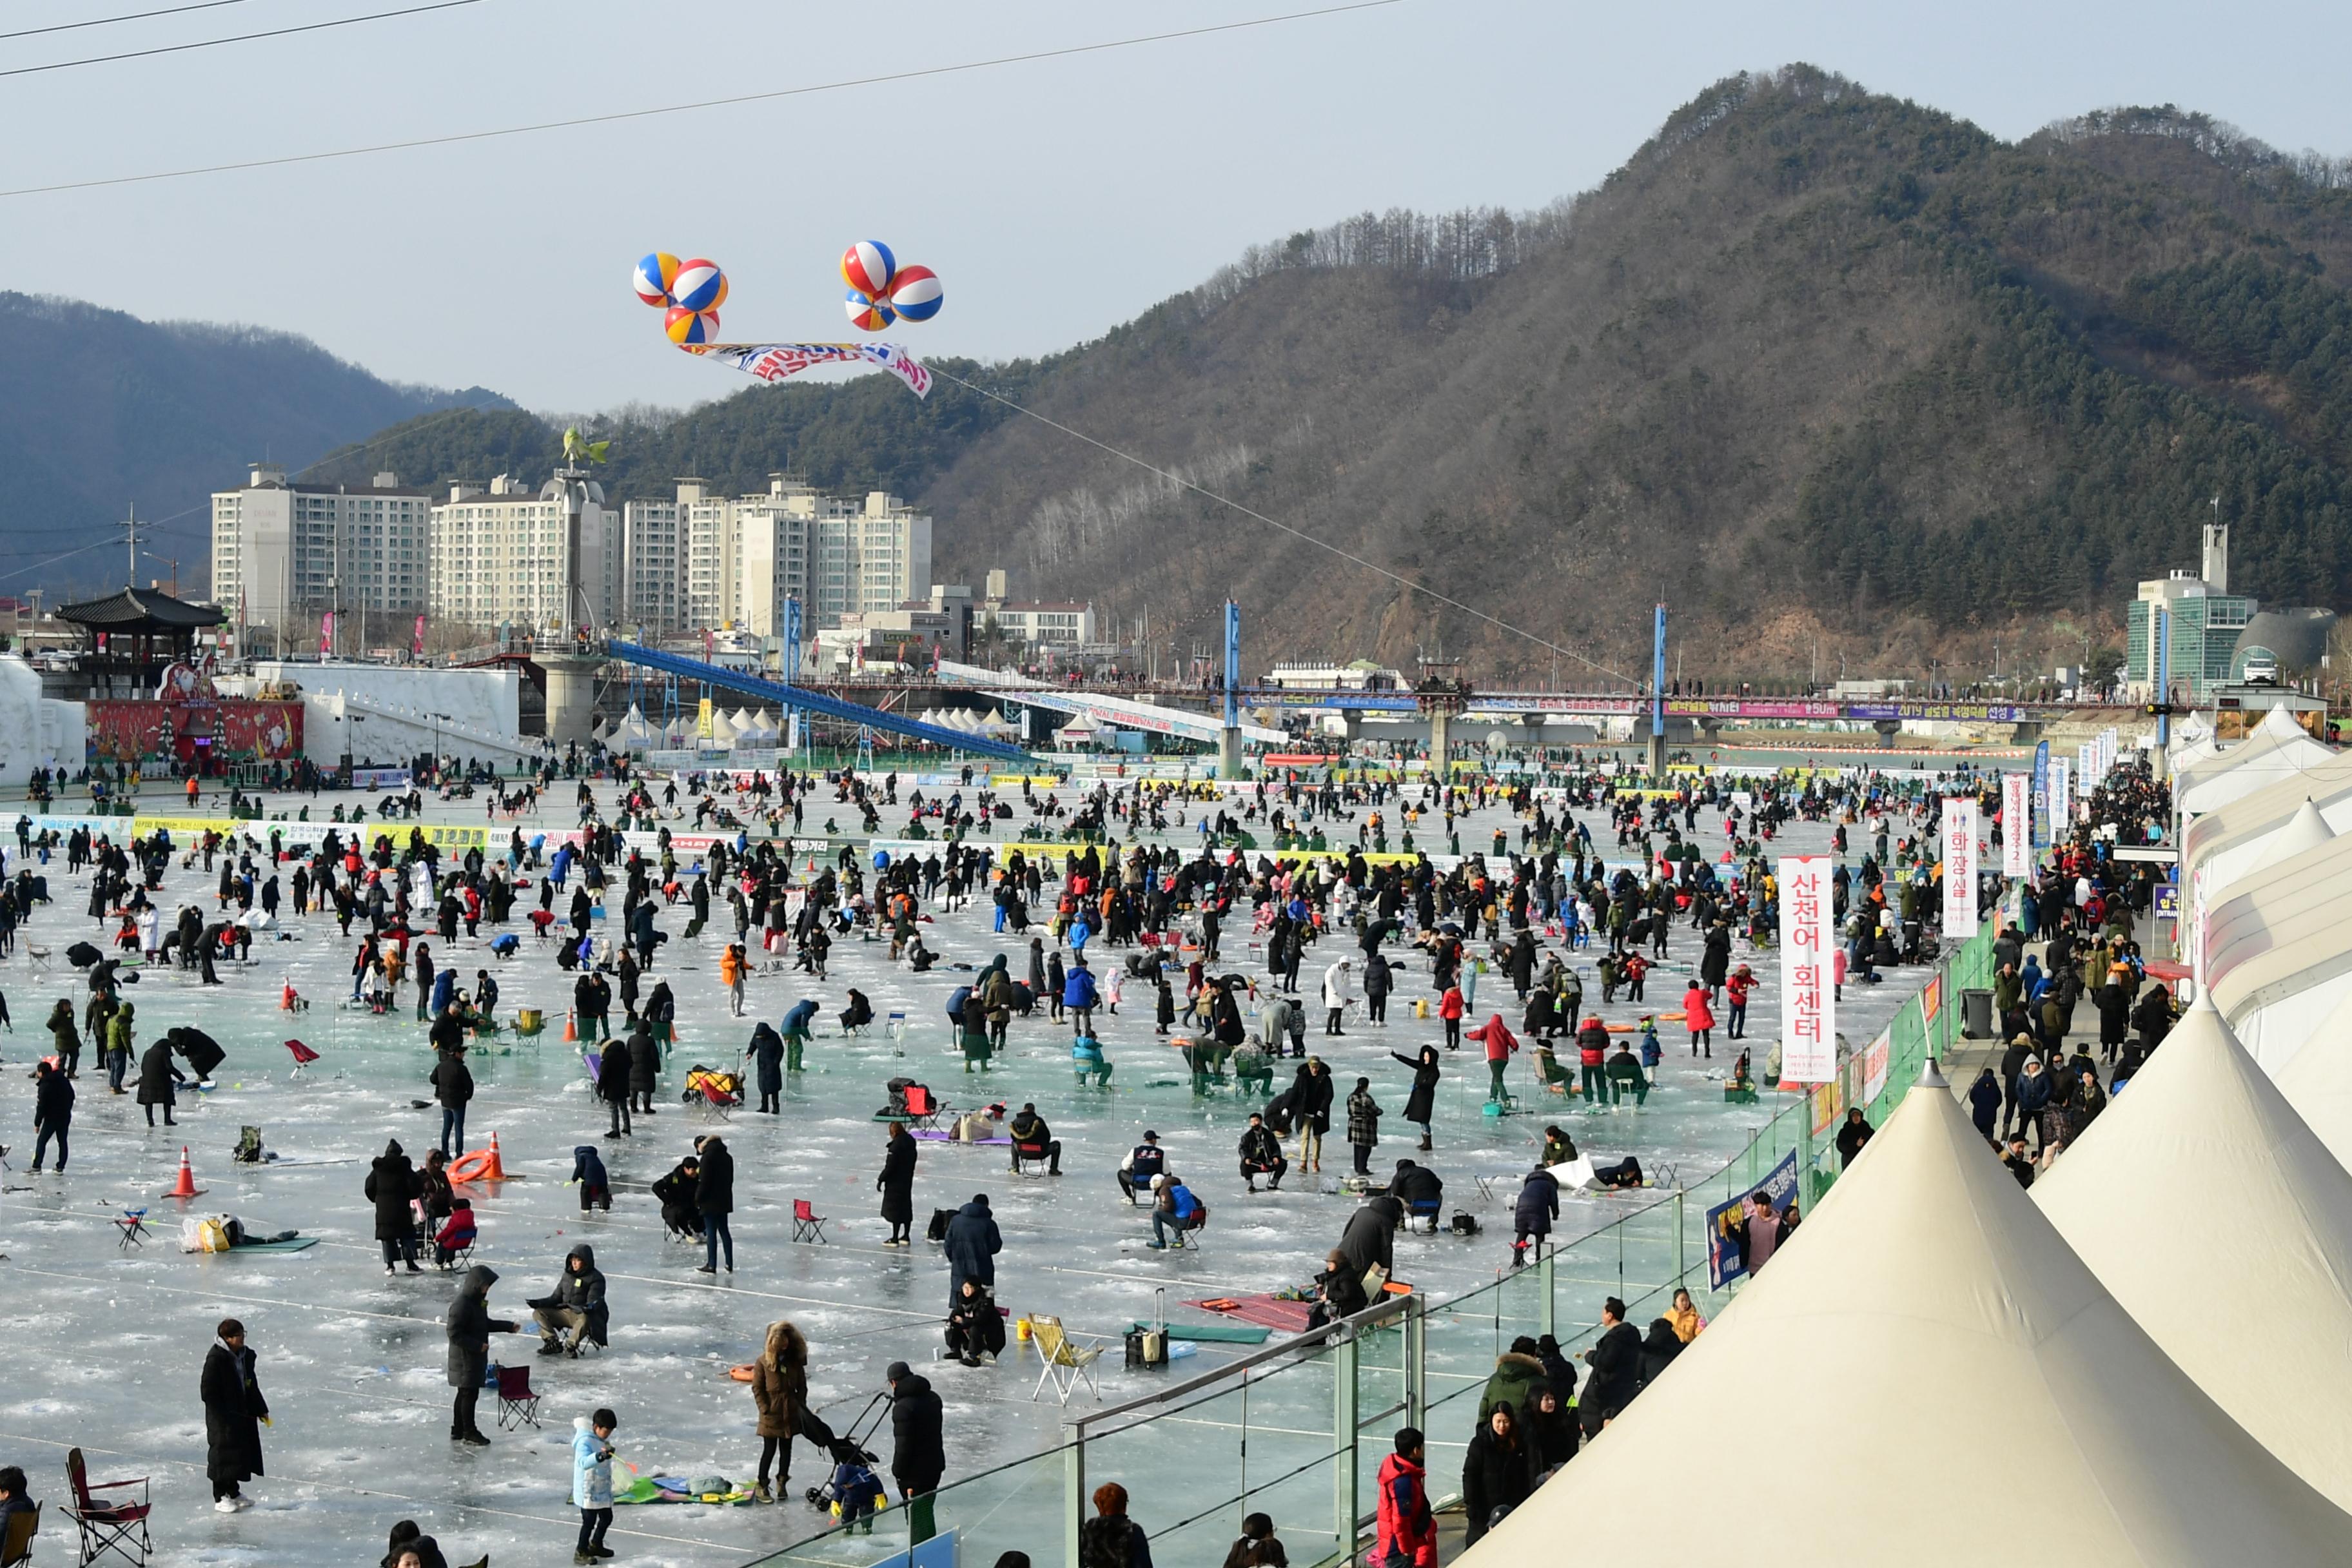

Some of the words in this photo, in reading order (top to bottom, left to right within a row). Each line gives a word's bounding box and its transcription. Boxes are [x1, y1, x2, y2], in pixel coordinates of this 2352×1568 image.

[2036, 792, 2043, 807] 5
[1951, 832, 1969, 897] 화장실
[2012, 850, 2020, 861] 2
[1790, 873, 1821, 952] 산천어
[1792, 964, 1821, 1043] 회센터
